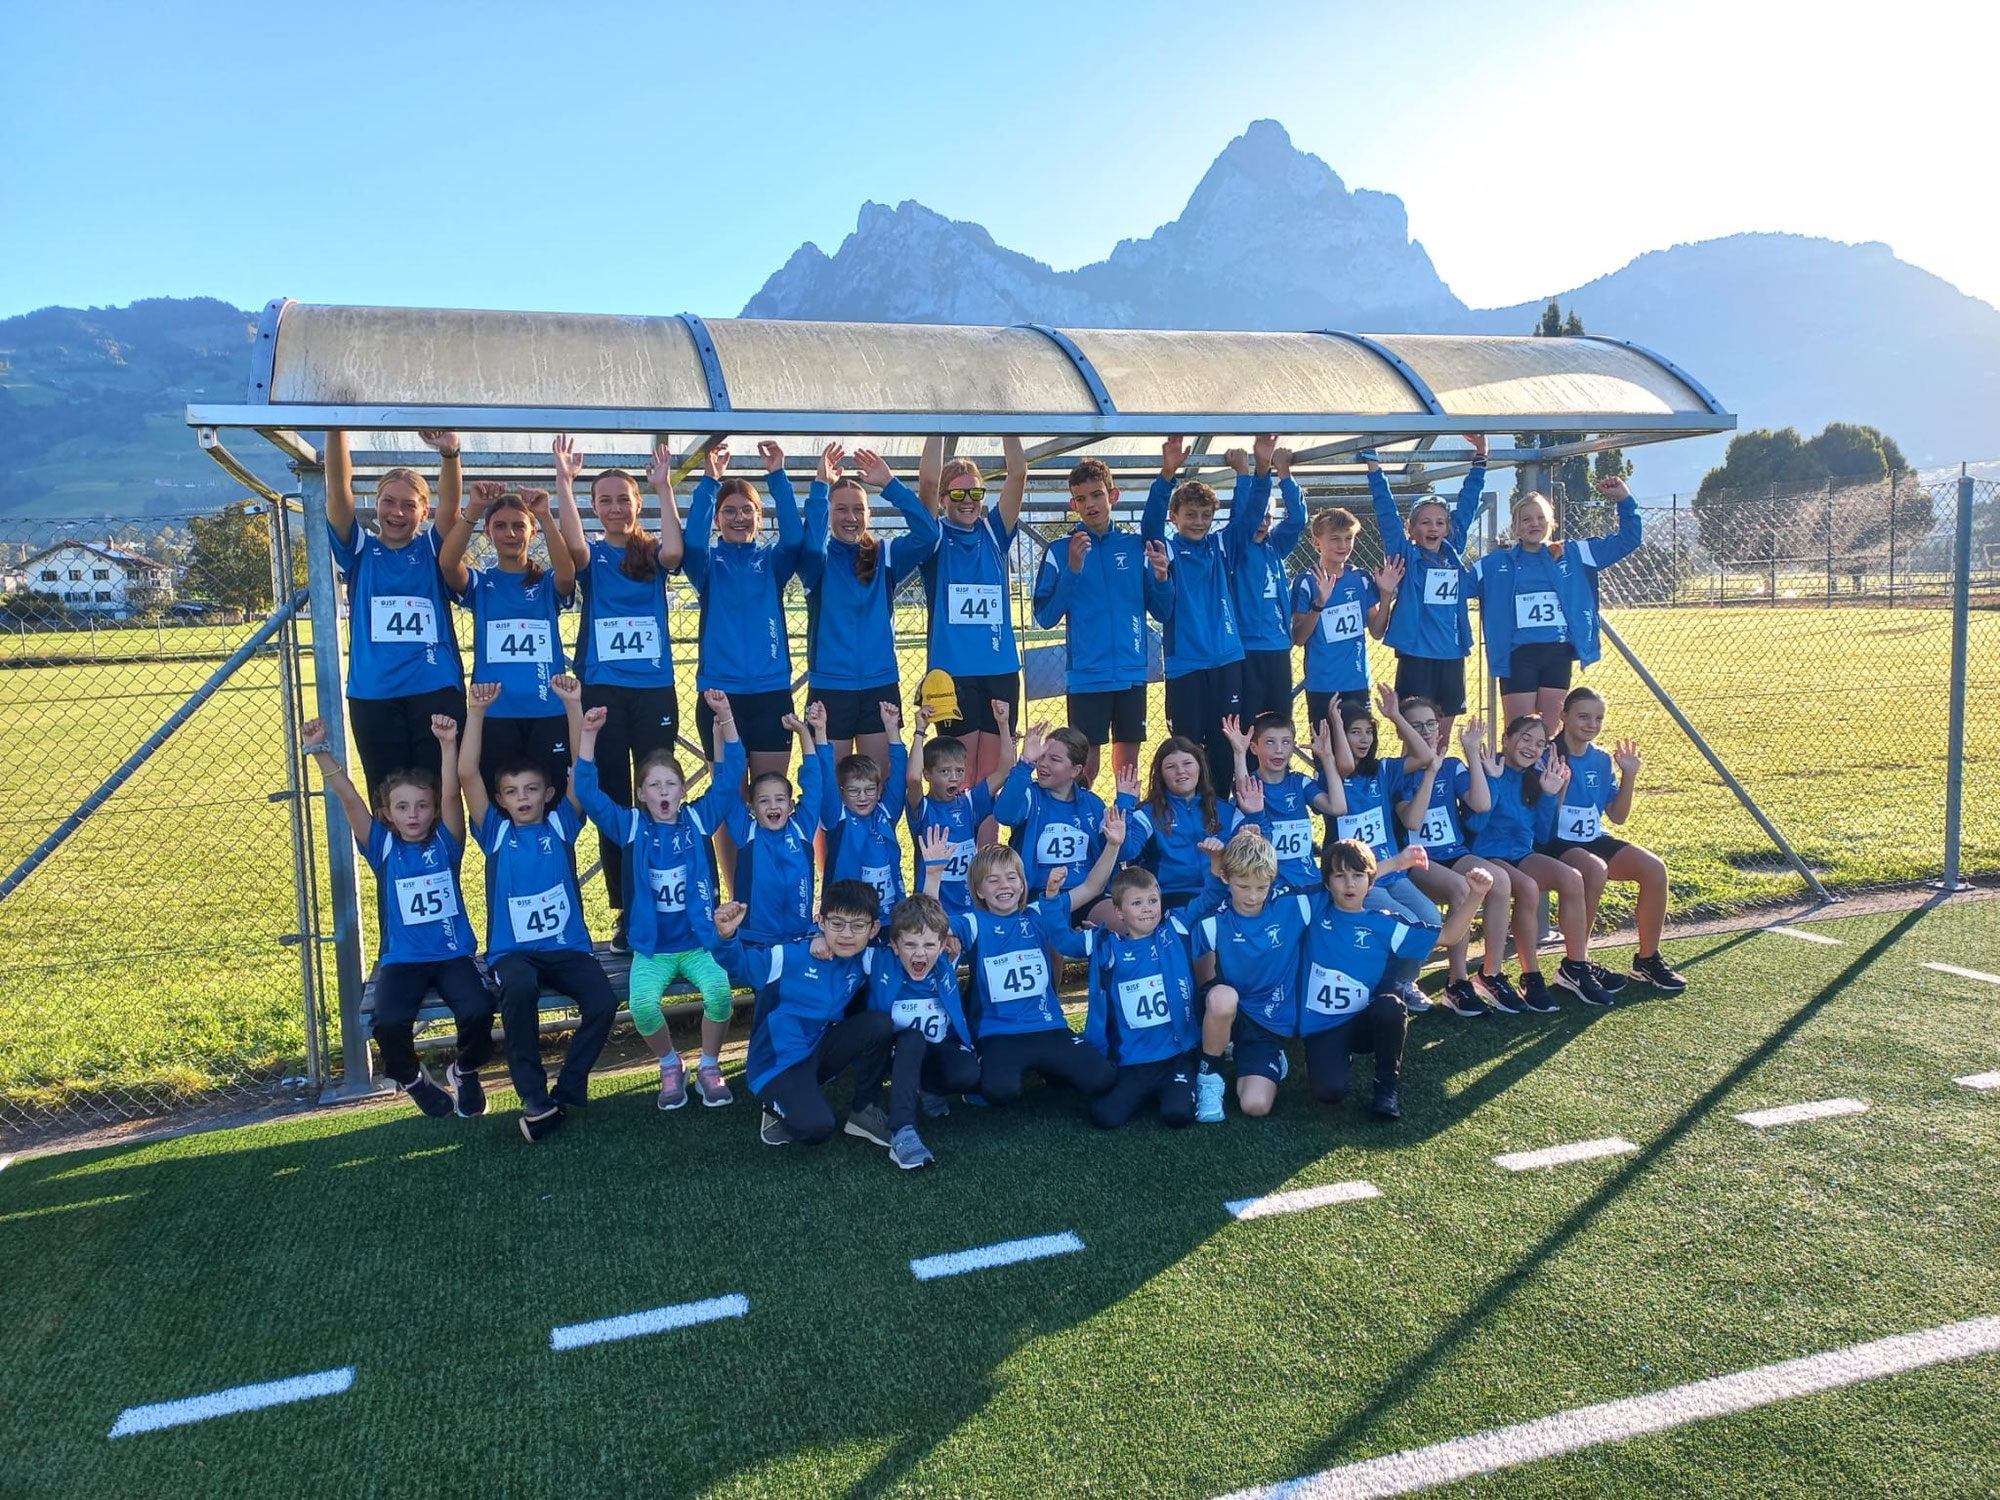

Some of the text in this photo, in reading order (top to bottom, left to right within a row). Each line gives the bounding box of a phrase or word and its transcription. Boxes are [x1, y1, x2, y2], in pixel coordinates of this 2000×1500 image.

[1435, 582, 1458, 600] 44
[960, 598, 997, 619] 44 6
[1528, 603, 1555, 622] 43
[386, 612, 431, 636] 44 1
[1335, 614, 1358, 635] 42
[500, 634, 546, 656] 44 5
[610, 631, 653, 653] 44 2
[1353, 821, 1381, 844] 43 5
[1419, 821, 1444, 842] 43
[1569, 819, 1596, 838] 43
[1046, 835, 1084, 858] 43 3
[1275, 833, 1308, 855] 46 4
[944, 854, 969, 876] 45
[410, 887, 450, 917] 45 5
[657, 881, 686, 906] 46
[526, 900, 566, 933] 45 4
[1003, 964, 1042, 992] 45 3
[1136, 991, 1169, 1020] 46
[1316, 985, 1361, 1009] 45 1
[909, 1015, 939, 1038] 46
